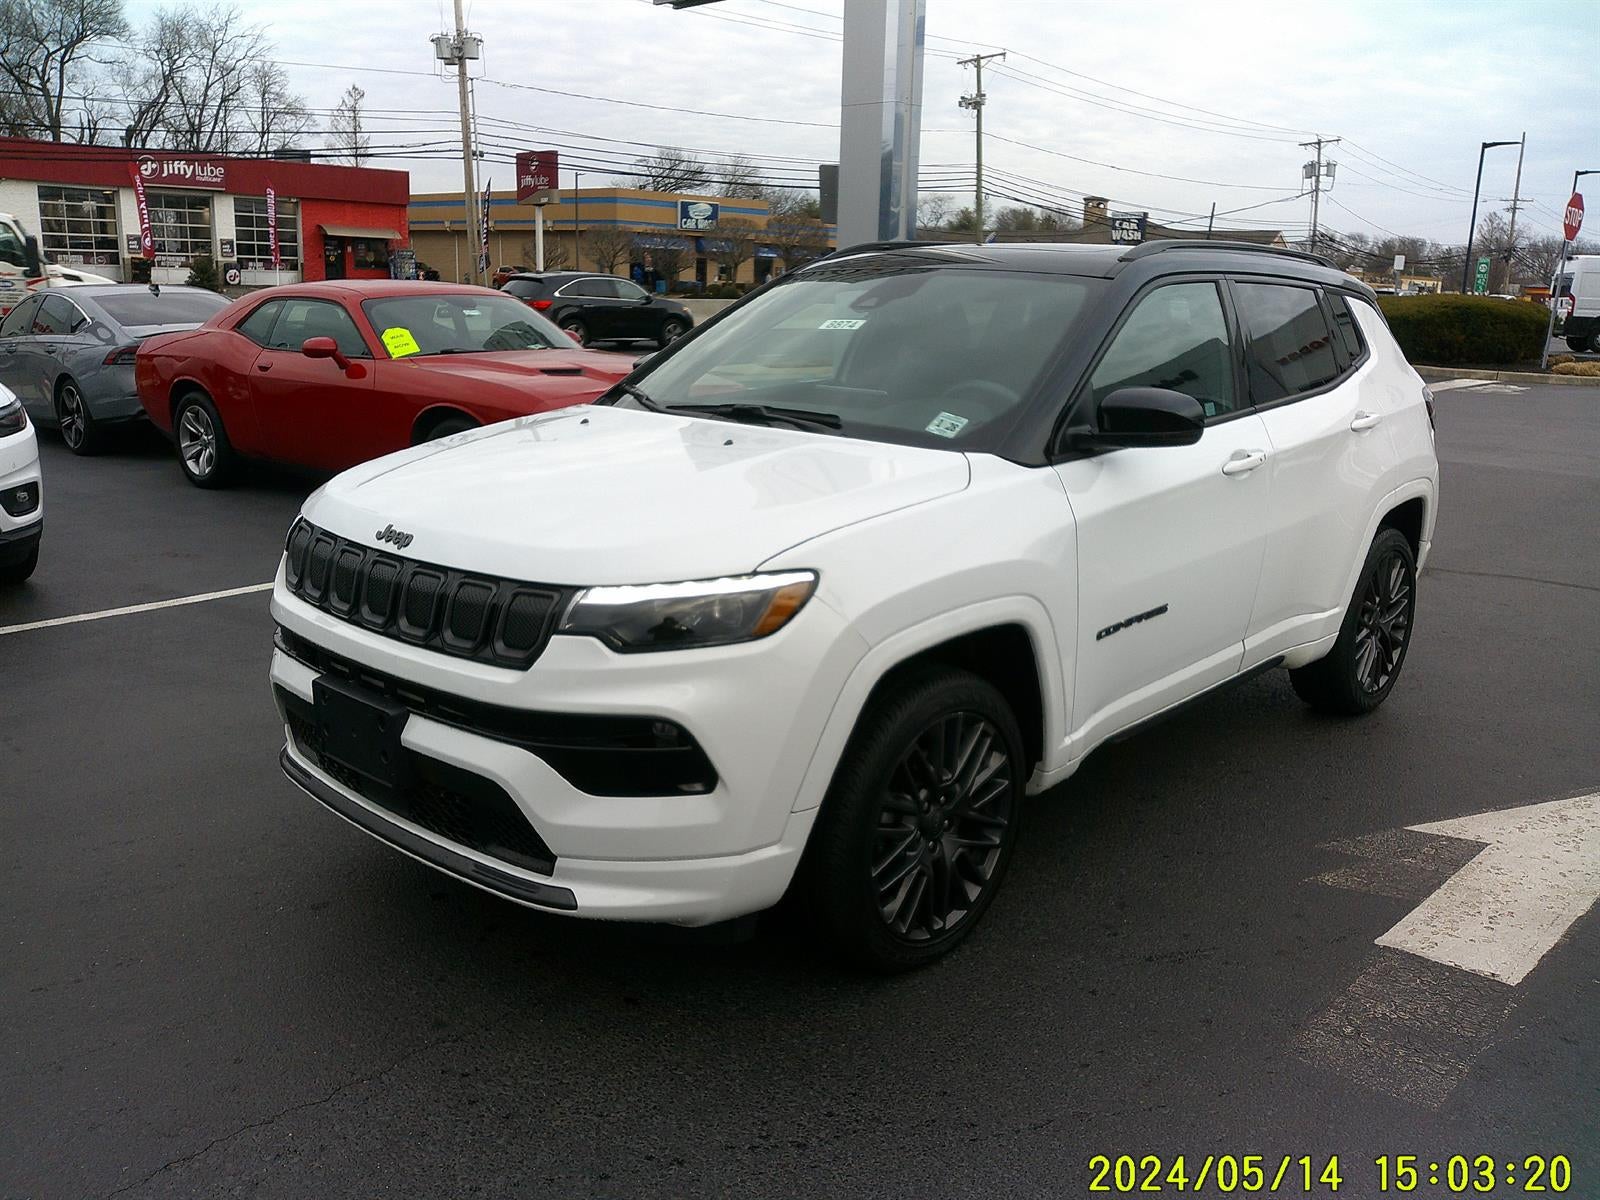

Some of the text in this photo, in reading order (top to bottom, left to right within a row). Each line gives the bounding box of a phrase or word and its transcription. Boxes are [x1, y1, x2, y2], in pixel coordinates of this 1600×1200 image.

[162, 160, 225, 178] jiffy lube
[520, 174, 549, 189] jiffy lube
[681, 218, 697, 229] CAR
[1115, 219, 1139, 229] CAR
[1565, 206, 1583, 228] STOP
[1111, 229, 1142, 241] WASH
[375, 523, 414, 550] Jeep
